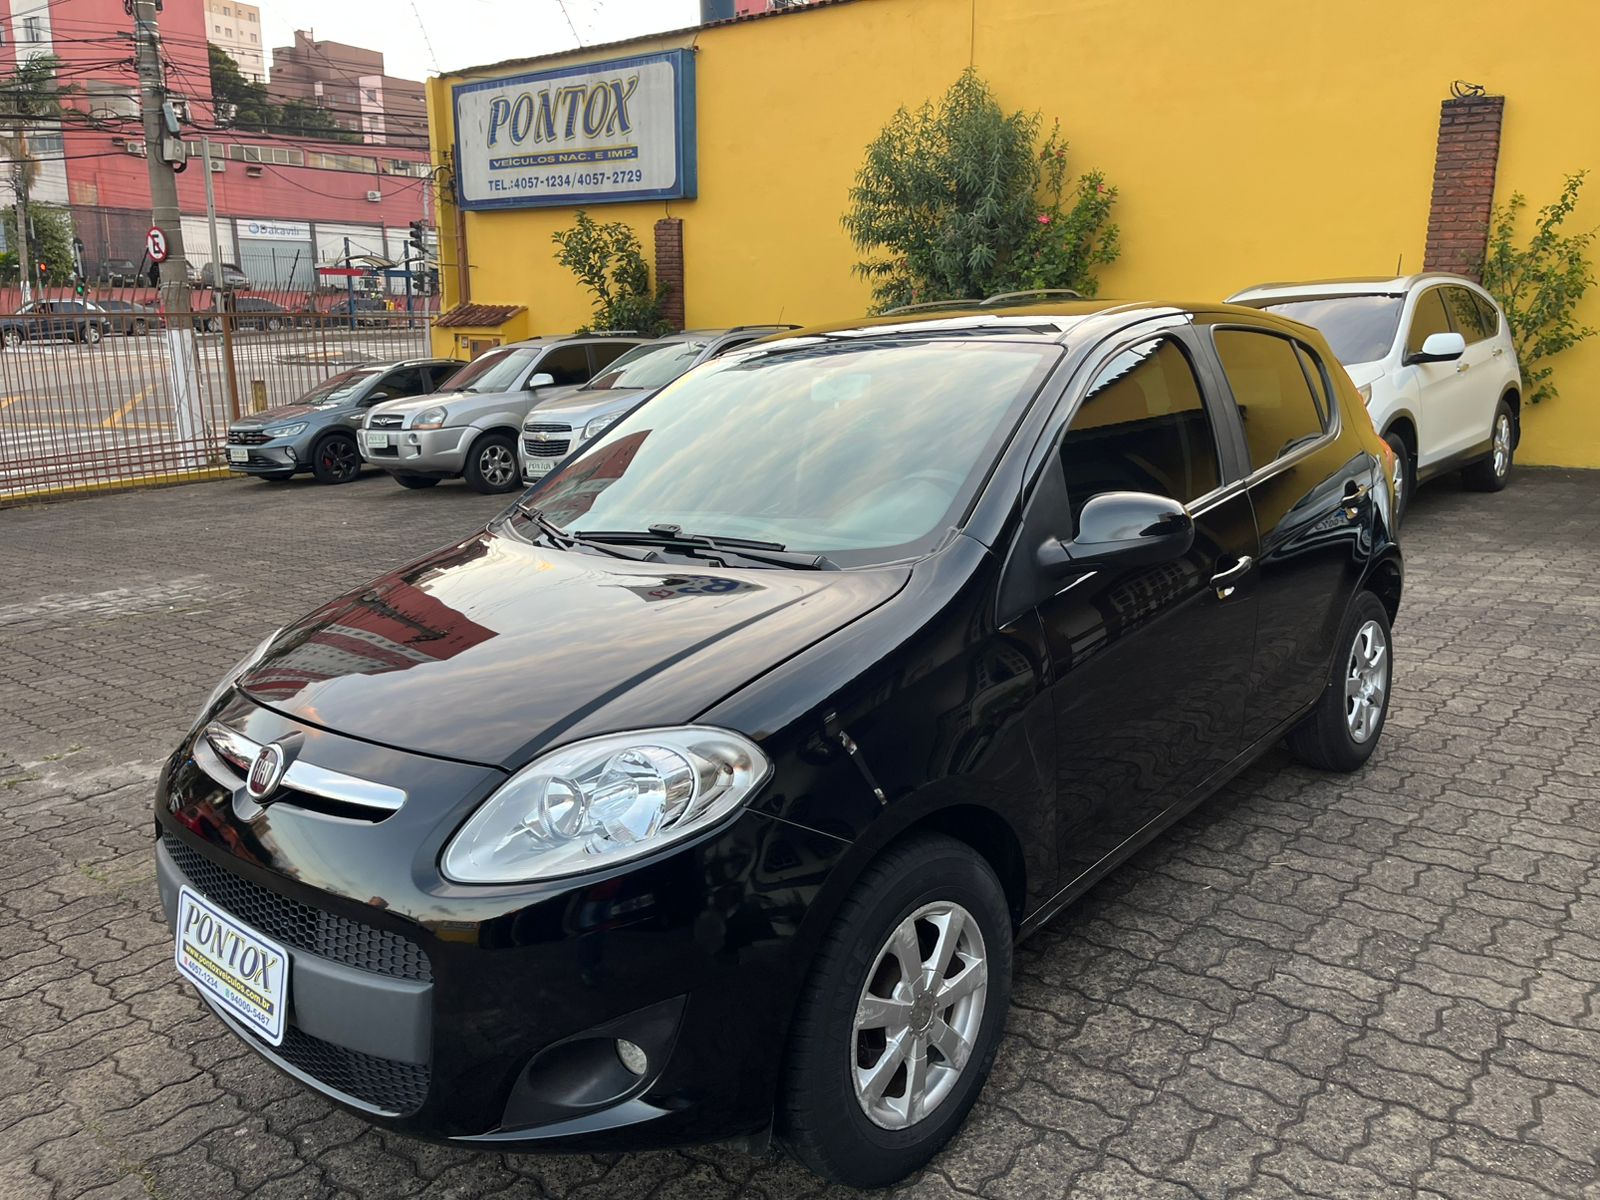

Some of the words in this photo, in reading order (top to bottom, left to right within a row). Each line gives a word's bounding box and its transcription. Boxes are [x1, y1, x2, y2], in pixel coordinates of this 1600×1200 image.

[487, 76, 639, 149] PONTOX
[559, 152, 591, 163] NAC.
[595, 151, 603, 159] E
[607, 149, 636, 159] IMP.
[253, 758, 274, 785] FIAT
[184, 902, 277, 993] PONTOX
